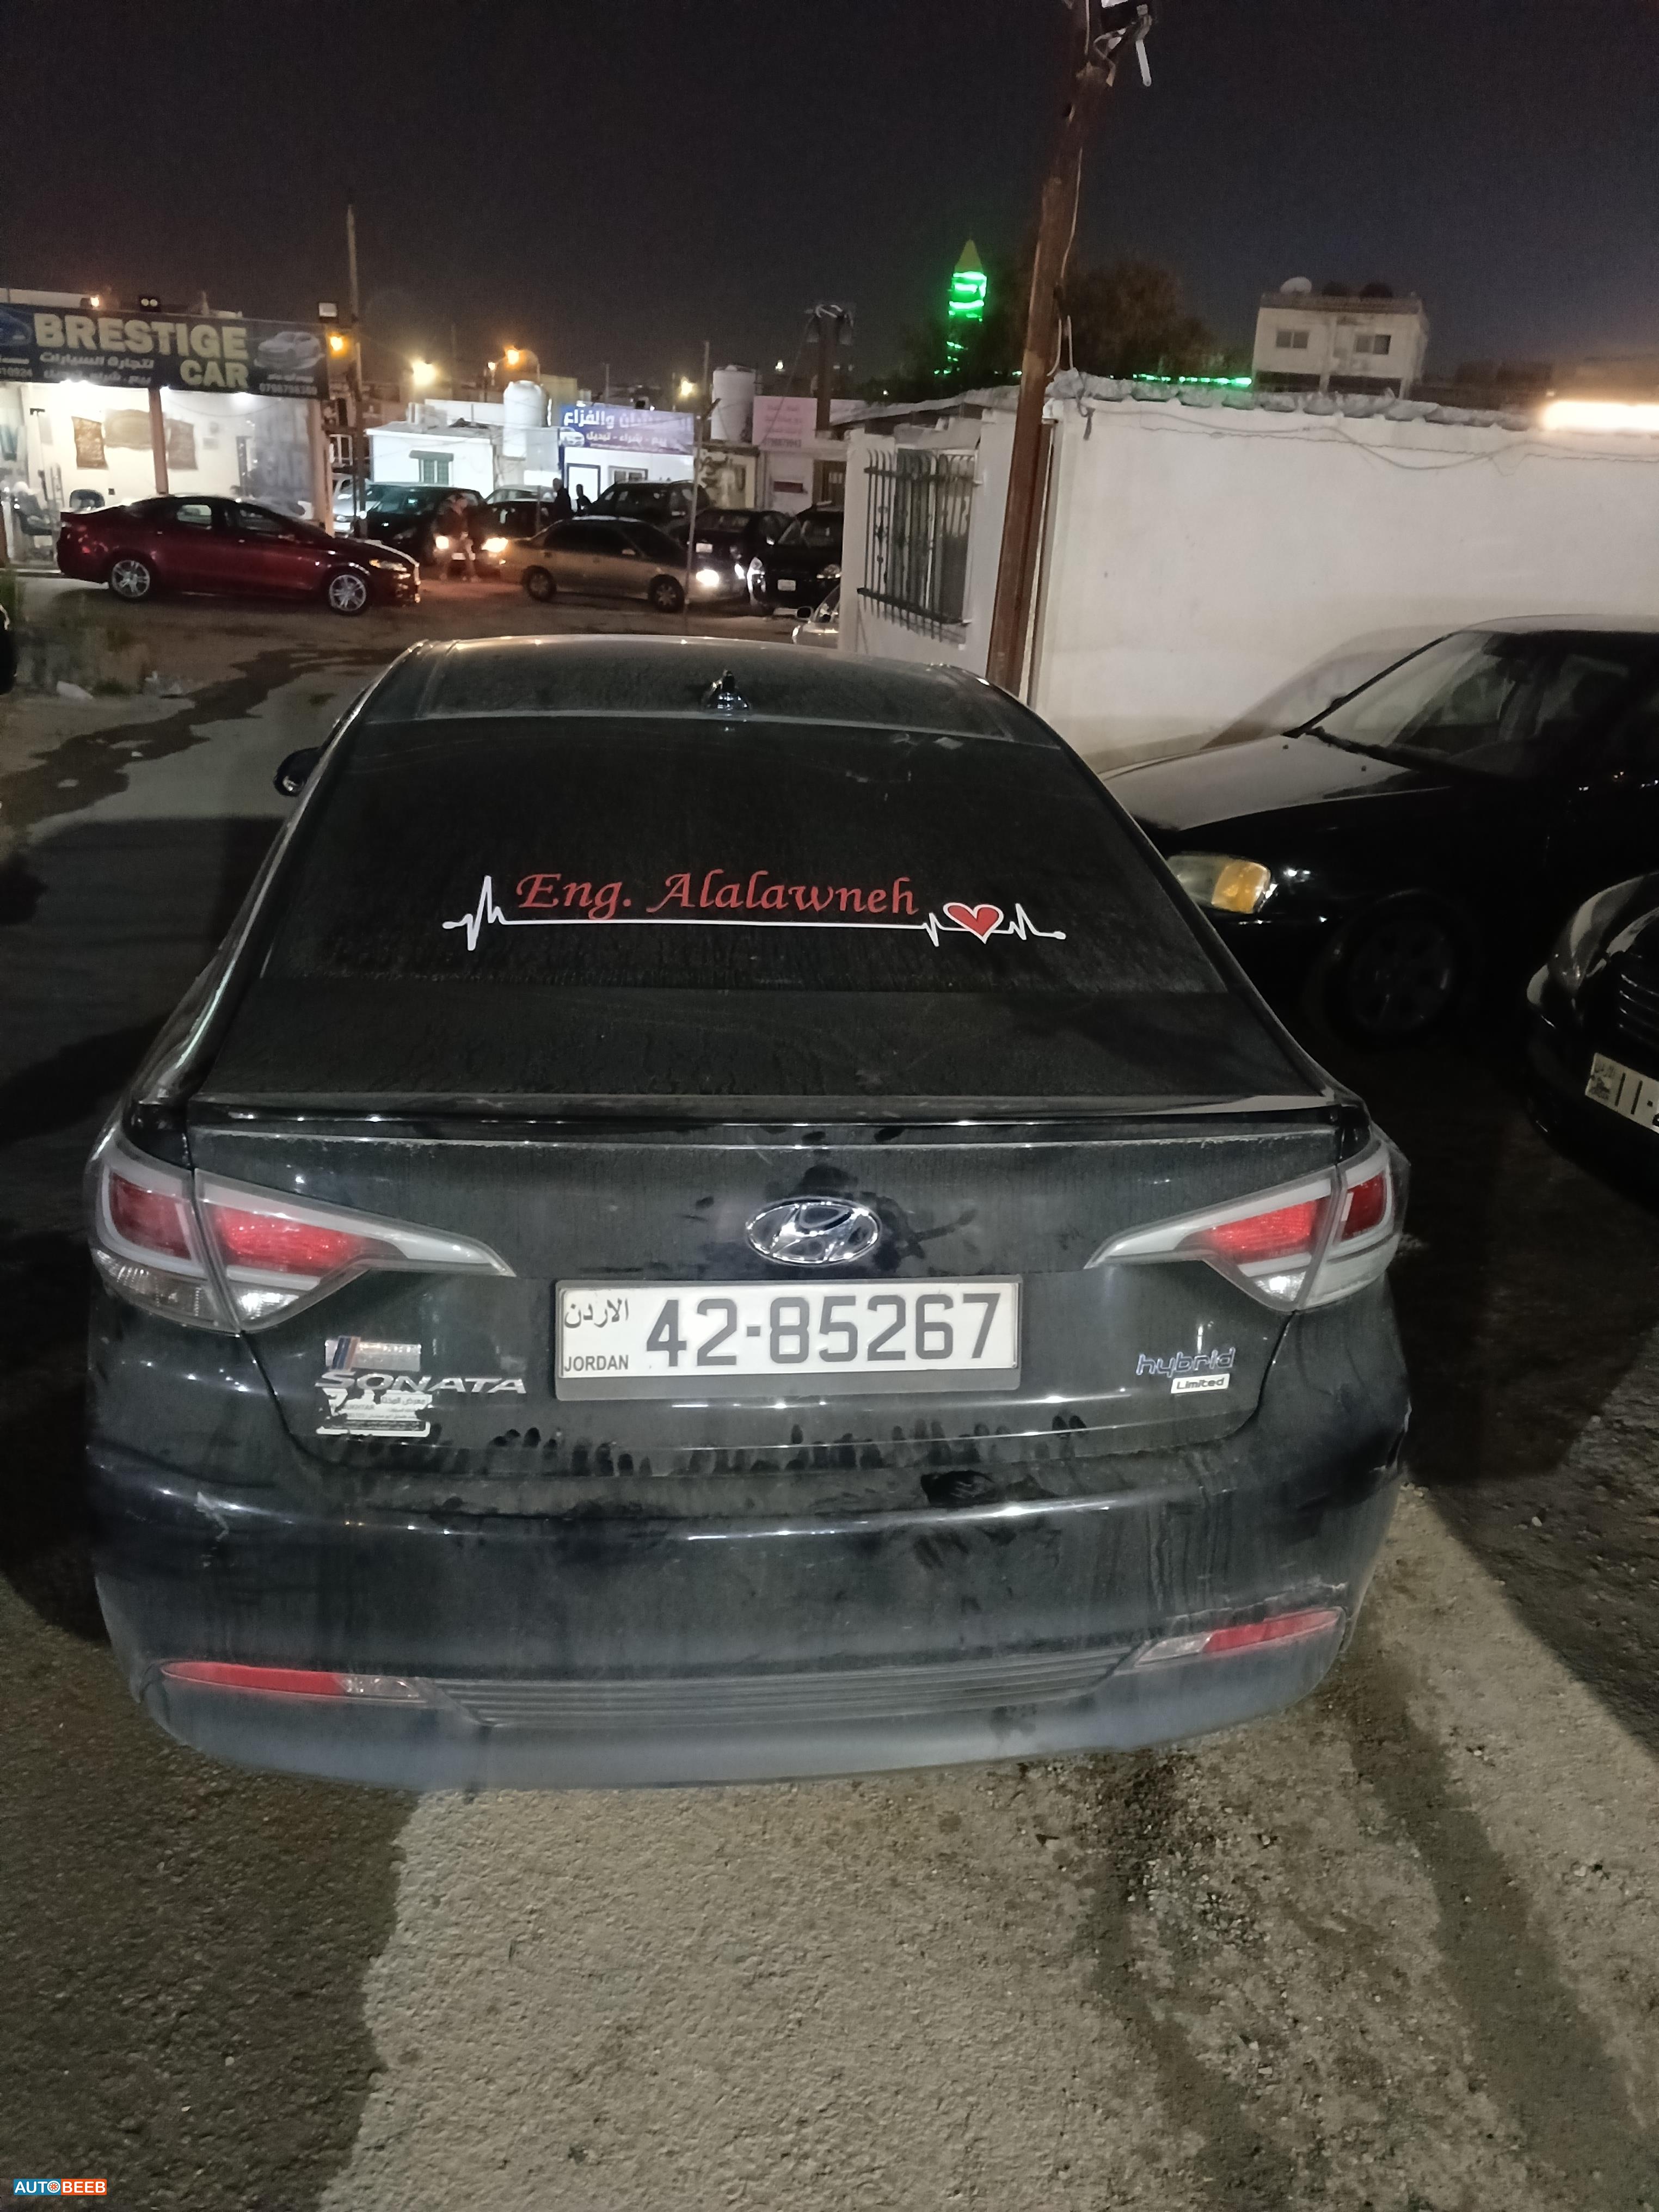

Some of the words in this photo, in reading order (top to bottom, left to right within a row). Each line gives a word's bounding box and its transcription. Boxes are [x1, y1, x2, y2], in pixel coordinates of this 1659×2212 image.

[34, 312, 249, 360] BRESTIGE
[180, 359, 249, 389] CAR
[516, 873, 631, 920] Eng.
[647, 869, 919, 916] Alalawneh
[563, 1298, 630, 1329] الاردن
[646, 1292, 1001, 1368] 42-85267
[563, 1354, 630, 1372] JORDAN
[1135, 1347, 1236, 1378] hybrid
[314, 1371, 527, 1394] SONATA
[1176, 1377, 1225, 1390] Limited
